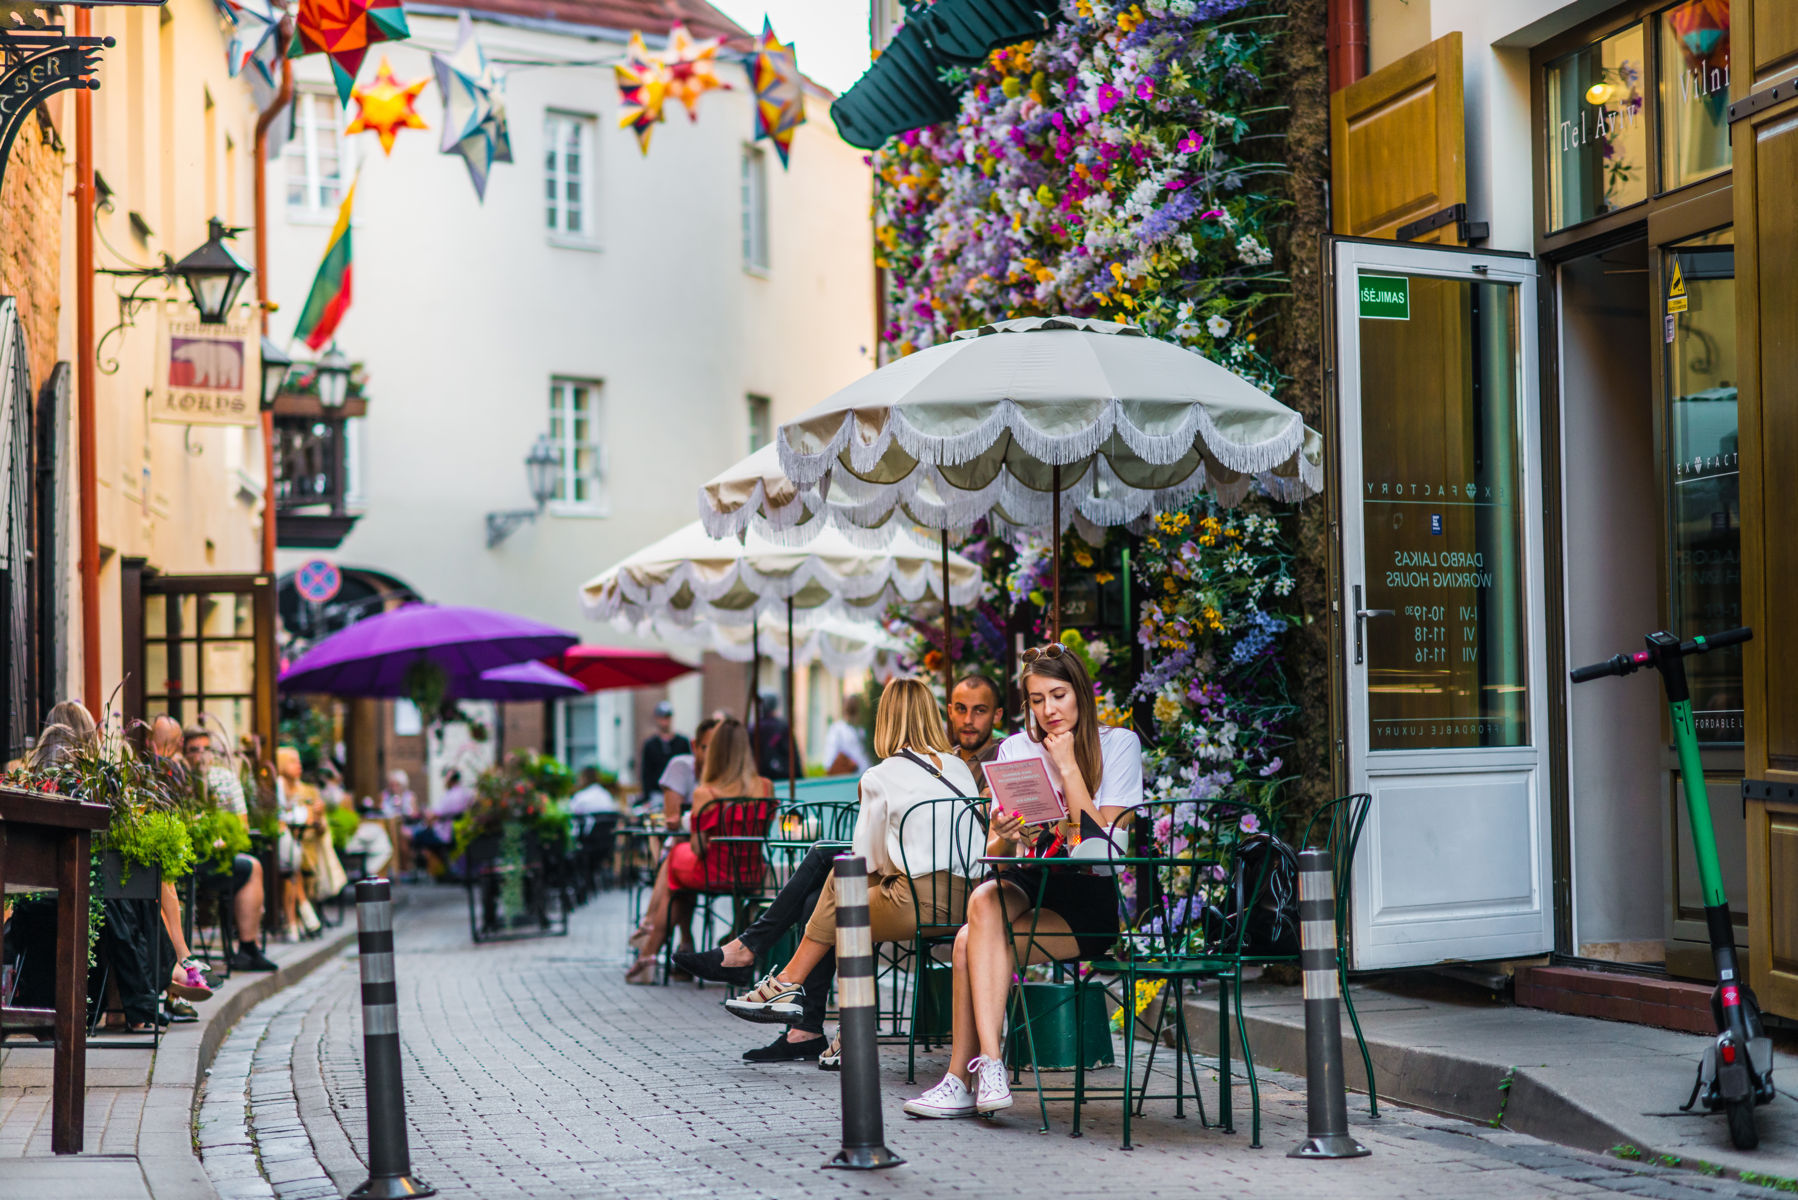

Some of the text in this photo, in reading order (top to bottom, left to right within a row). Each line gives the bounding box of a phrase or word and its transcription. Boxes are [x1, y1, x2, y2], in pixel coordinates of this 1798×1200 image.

[1561, 101, 1636, 152] Tel Aviv
[1360, 287, 1405, 304] IŠĖJIMAS
[1676, 461, 1690, 475] EX
